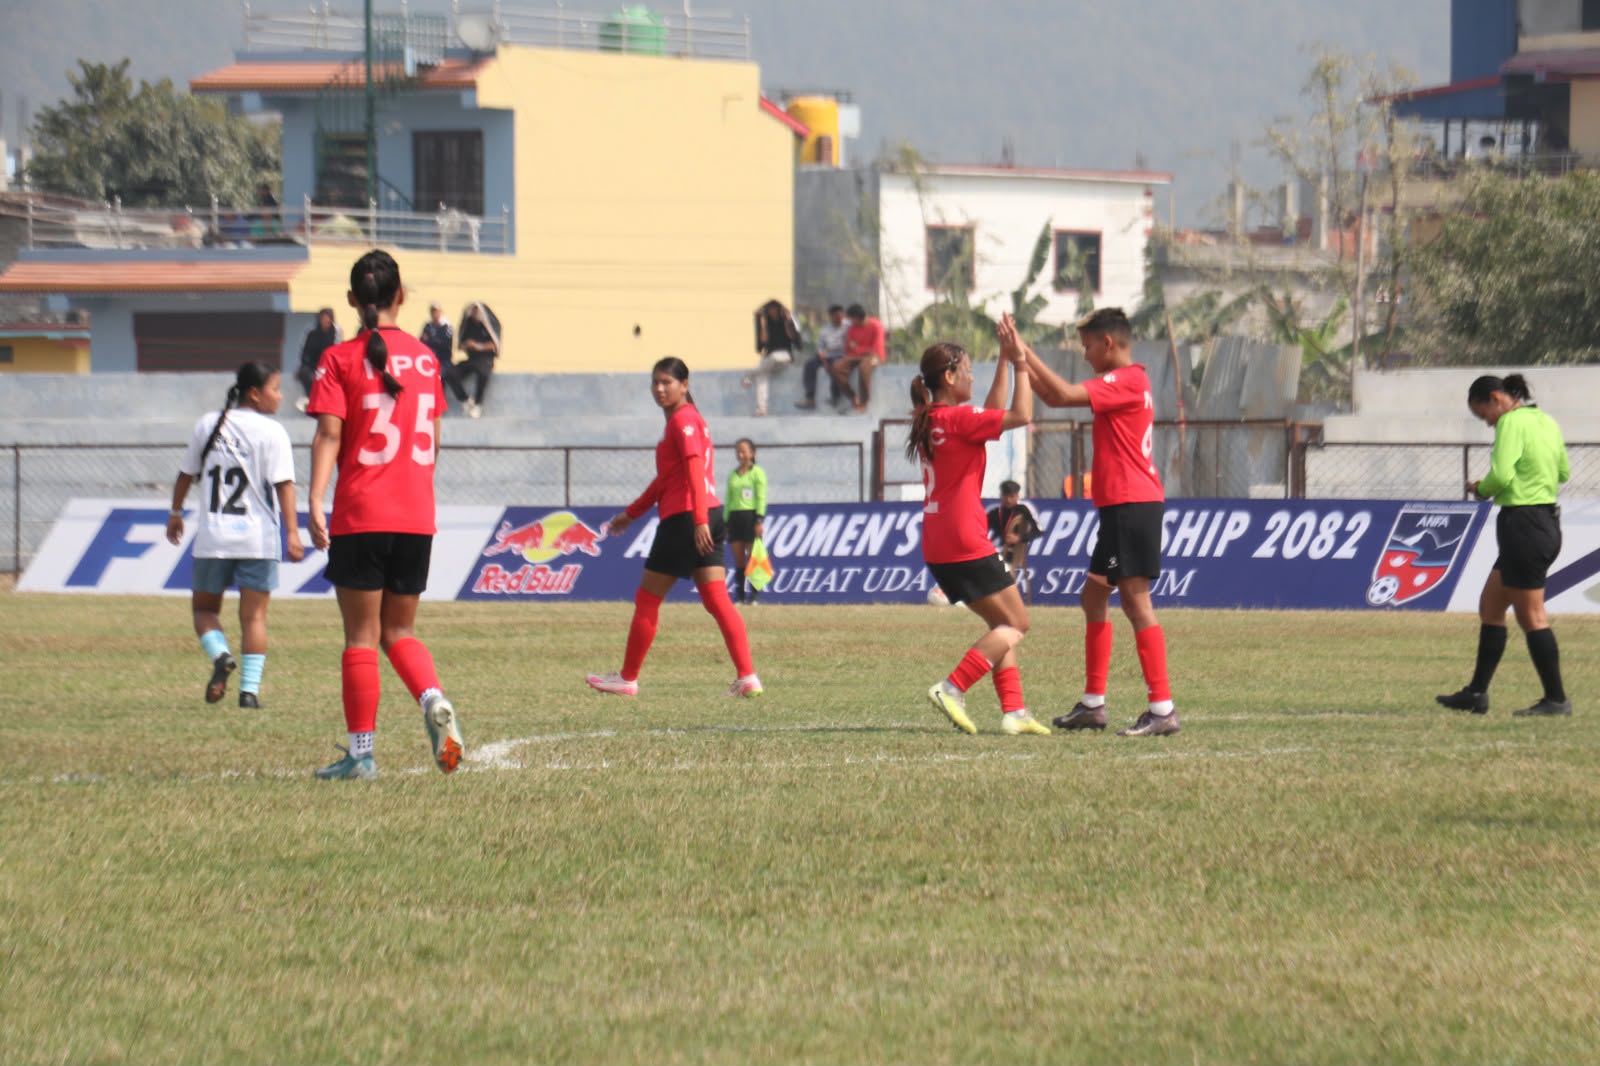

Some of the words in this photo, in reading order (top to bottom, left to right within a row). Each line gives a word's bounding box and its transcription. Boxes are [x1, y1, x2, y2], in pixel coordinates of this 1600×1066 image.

[357, 392, 435, 466] 35
[208, 464, 249, 516] 12
[1251, 510, 1373, 560] 2082
[1416, 515, 1450, 528] ANFA
[472, 564, 531, 593] Red
[521, 564, 583, 593] Bull
